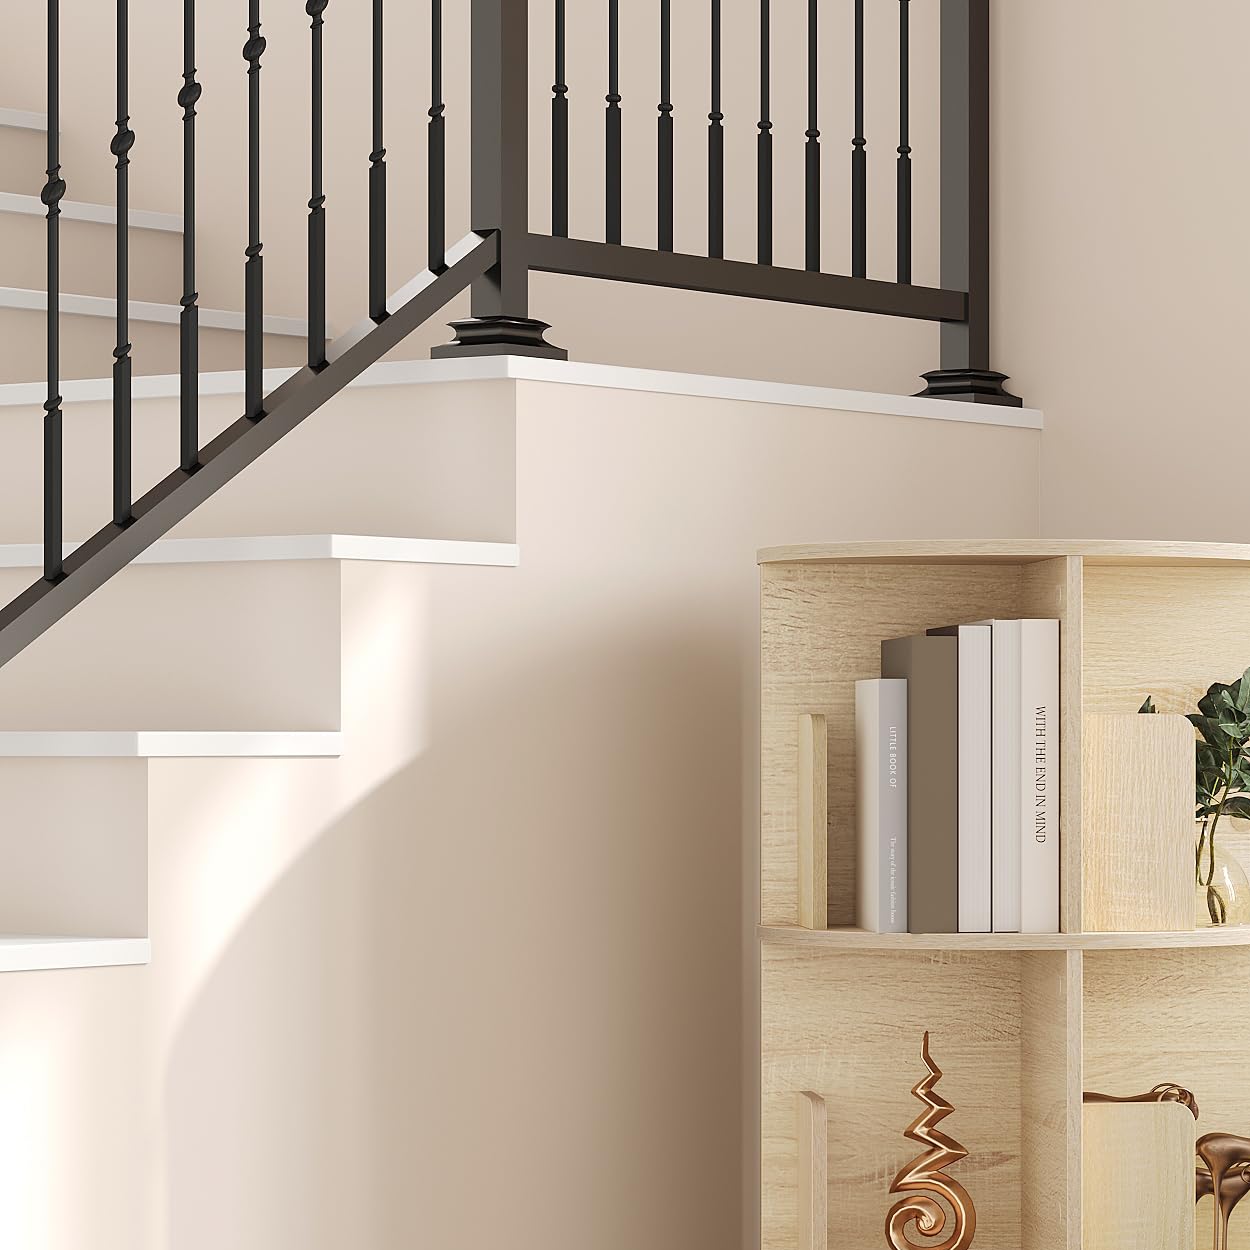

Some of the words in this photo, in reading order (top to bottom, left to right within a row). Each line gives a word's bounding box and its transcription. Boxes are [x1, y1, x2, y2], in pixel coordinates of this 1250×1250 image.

[1035, 705, 1047, 737] WITH
[889, 726, 897, 751] LITTLE
[889, 753, 897, 775] BOOK
[1035, 740, 1047, 764] THE
[889, 778, 897, 788] OF
[1035, 767, 1047, 792] END
[1035, 795, 1047, 807] IN
[1035, 810, 1047, 846] MIND
